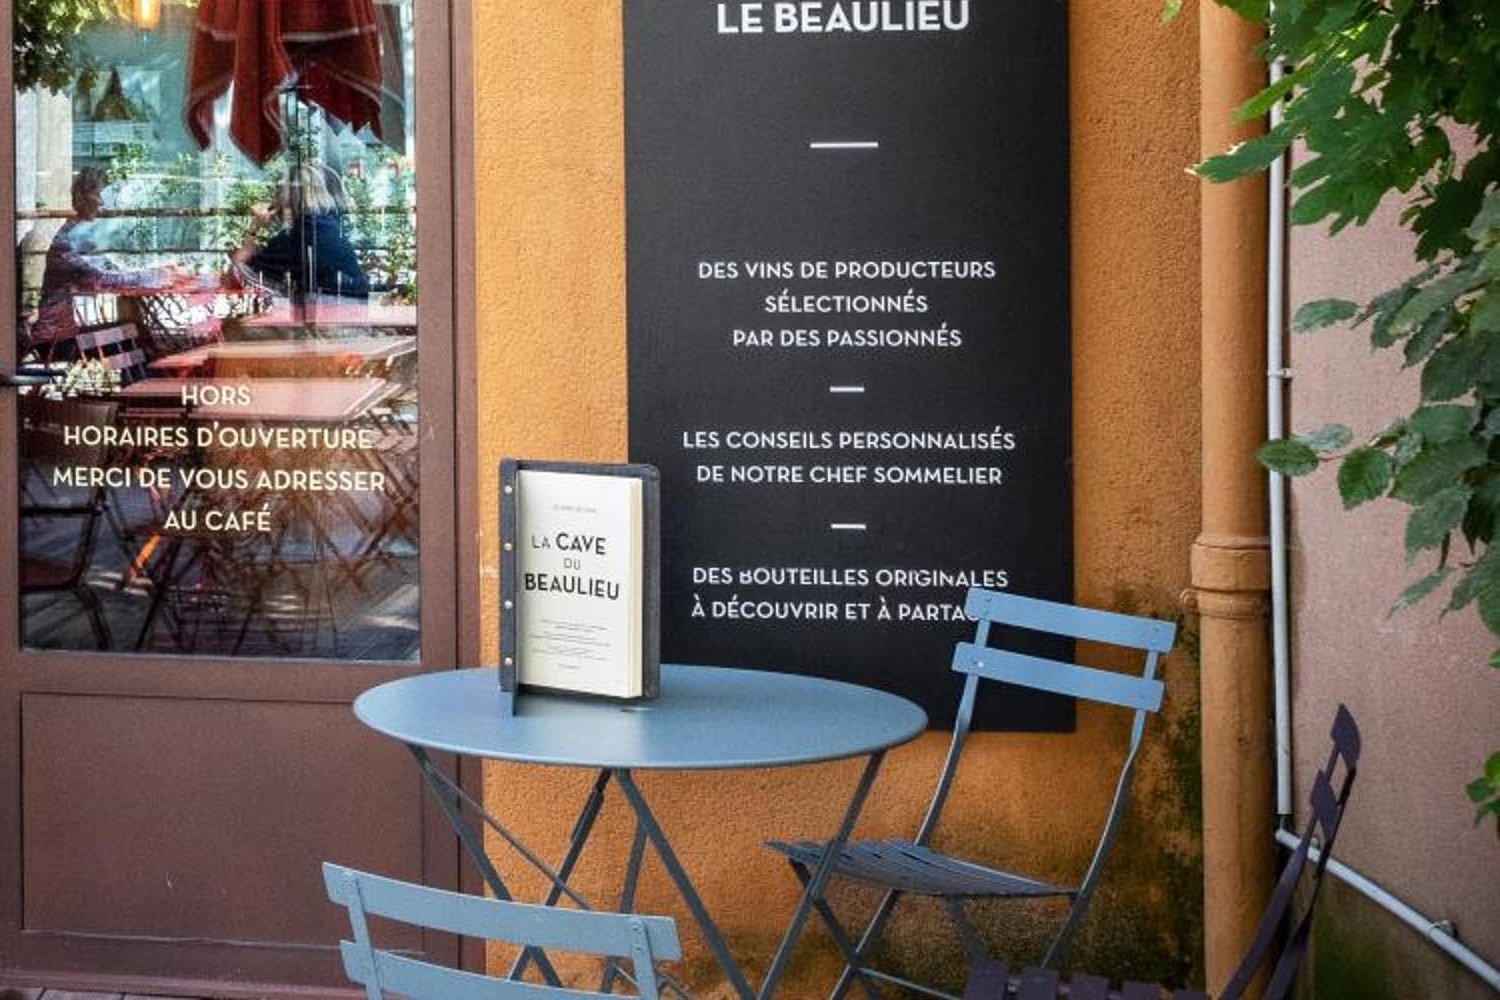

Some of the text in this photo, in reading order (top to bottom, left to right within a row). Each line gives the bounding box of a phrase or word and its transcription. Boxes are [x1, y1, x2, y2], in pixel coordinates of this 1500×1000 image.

[718, 0, 968, 33] LE BEAULIEU
[699, 261, 995, 278] DES VINS DE PRODUCTEURS
[765, 288, 927, 312] SÉLECTIONNÉS
[734, 323, 961, 346] PAR DES PASSIONNÉS
[181, 385, 251, 406] HORS
[64, 421, 374, 450] HORAIRES D'OUVERTURE
[684, 426, 1015, 449] LES CONSEILS PERSONNALISÉS
[53, 467, 385, 491] MERCI DE VOUS ADRESSER
[697, 466, 1001, 484] DE NOTRE CHEF SOMMELIER
[164, 504, 271, 532] AU CAFÉ
[532, 532, 606, 555] LA CAVE
[564, 557, 580, 570] DU
[524, 573, 619, 600] BEAULIEU
[694, 568, 1008, 588] DES BOUTEILLES ORIGINALES
[692, 594, 705, 617] À
[712, 594, 838, 619] DÉCOUVRIR
[845, 603, 870, 619] ET
[878, 596, 891, 620] À
